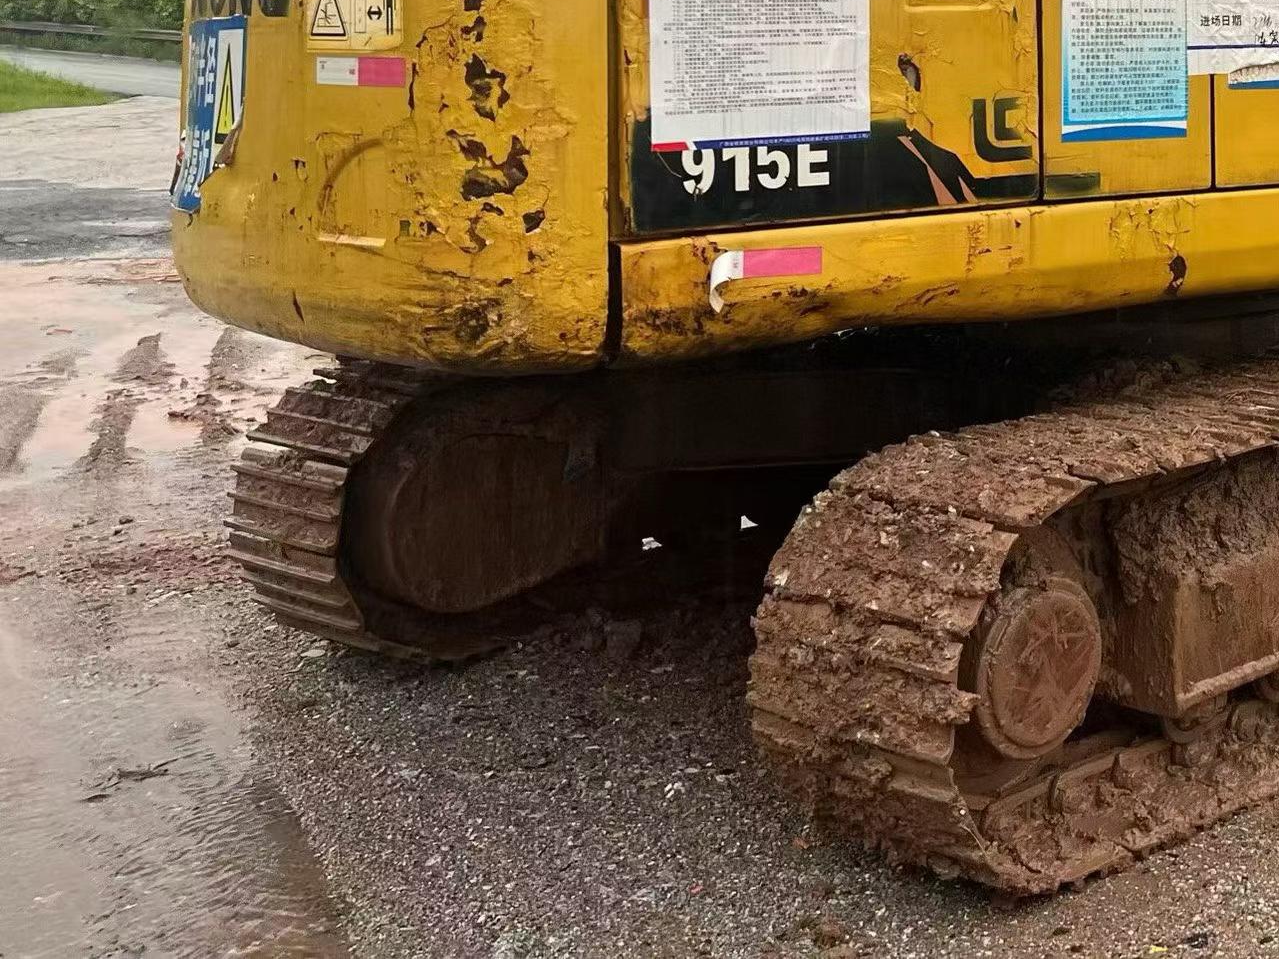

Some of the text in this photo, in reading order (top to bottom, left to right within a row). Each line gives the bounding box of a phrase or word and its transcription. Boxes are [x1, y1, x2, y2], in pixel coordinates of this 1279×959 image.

[1199, 14, 1243, 27] 进场日期
[681, 143, 831, 195] 915E
